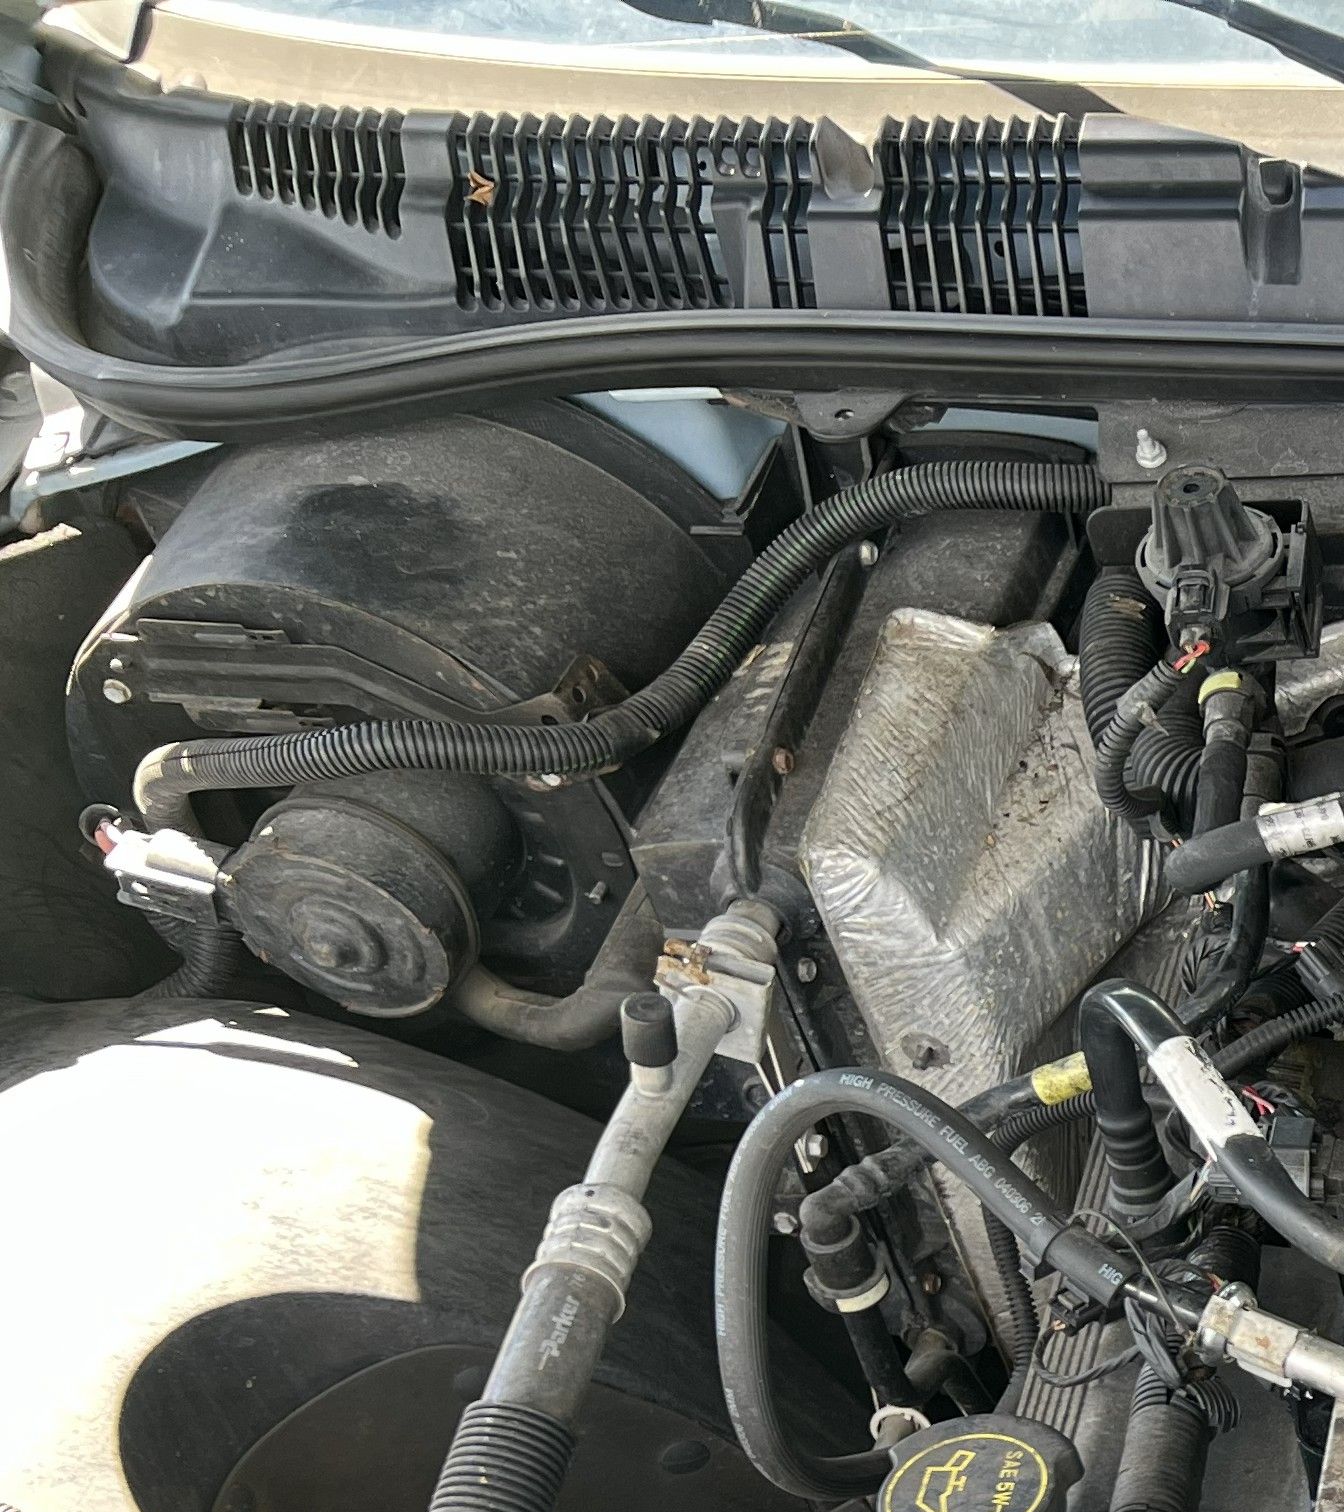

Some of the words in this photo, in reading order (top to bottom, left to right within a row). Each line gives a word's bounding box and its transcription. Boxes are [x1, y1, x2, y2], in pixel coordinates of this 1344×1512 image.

[838, 1072, 874, 1091] HIGH
[875, 1081, 942, 1129] PRESSURE
[938, 1123, 969, 1156] FUEL
[967, 1154, 993, 1181] ABG
[540, 1294, 580, 1357] Parker
[999, 1450, 1024, 1479] SAE
